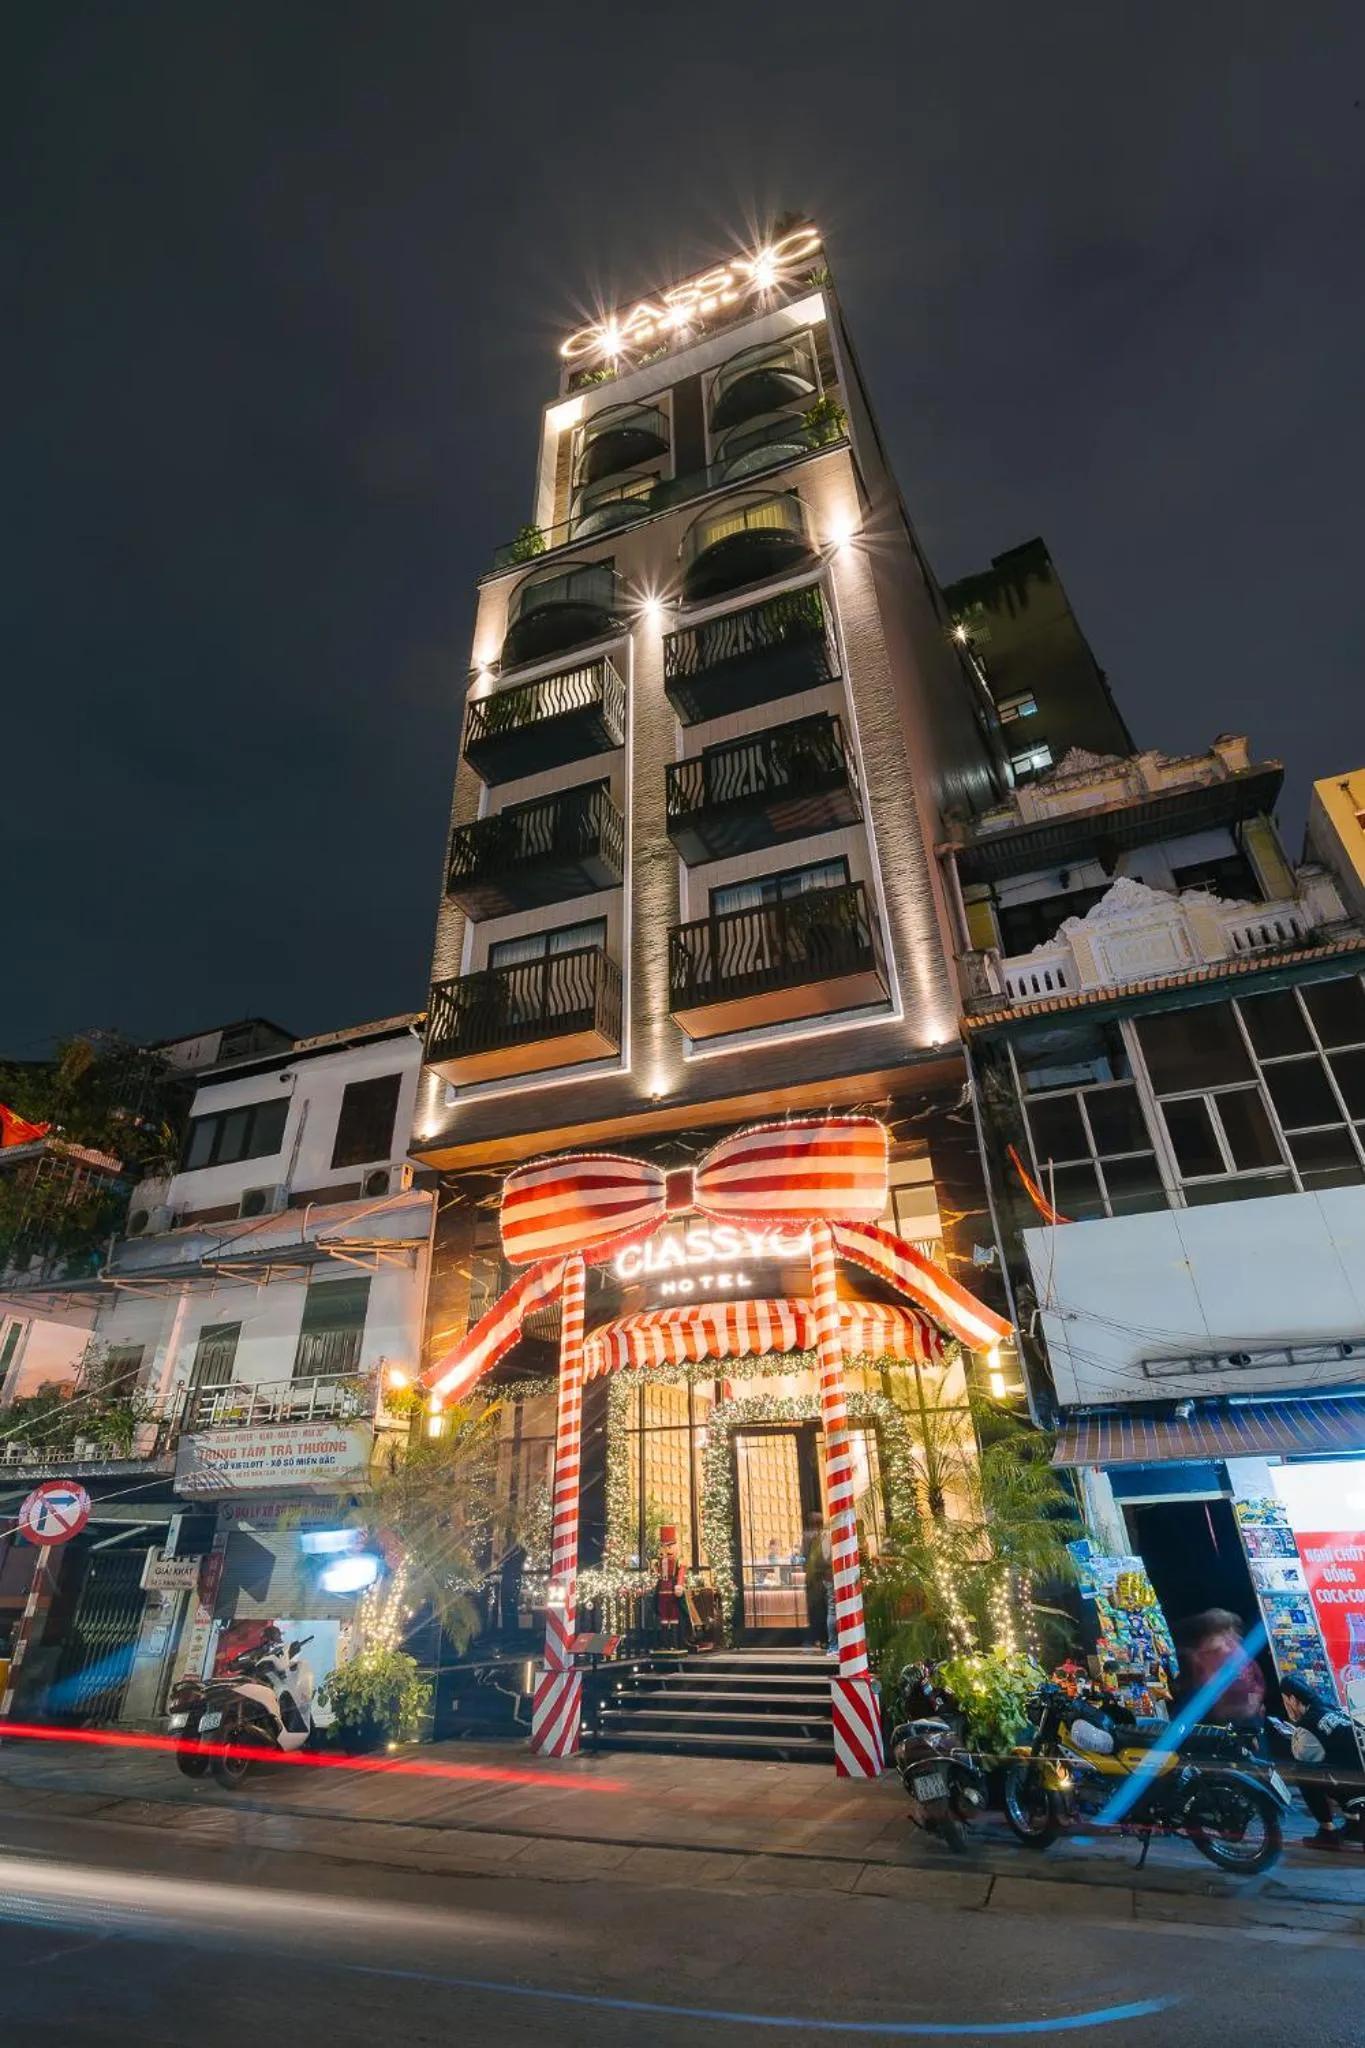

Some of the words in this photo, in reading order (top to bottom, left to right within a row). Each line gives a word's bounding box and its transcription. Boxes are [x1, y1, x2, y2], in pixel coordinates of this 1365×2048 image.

[660, 1272, 752, 1296] HOTEL
[199, 1447, 237, 1461] TRUNG
[240, 1444, 266, 1458] TÂM
[270, 1440, 294, 1457] TRẢ
